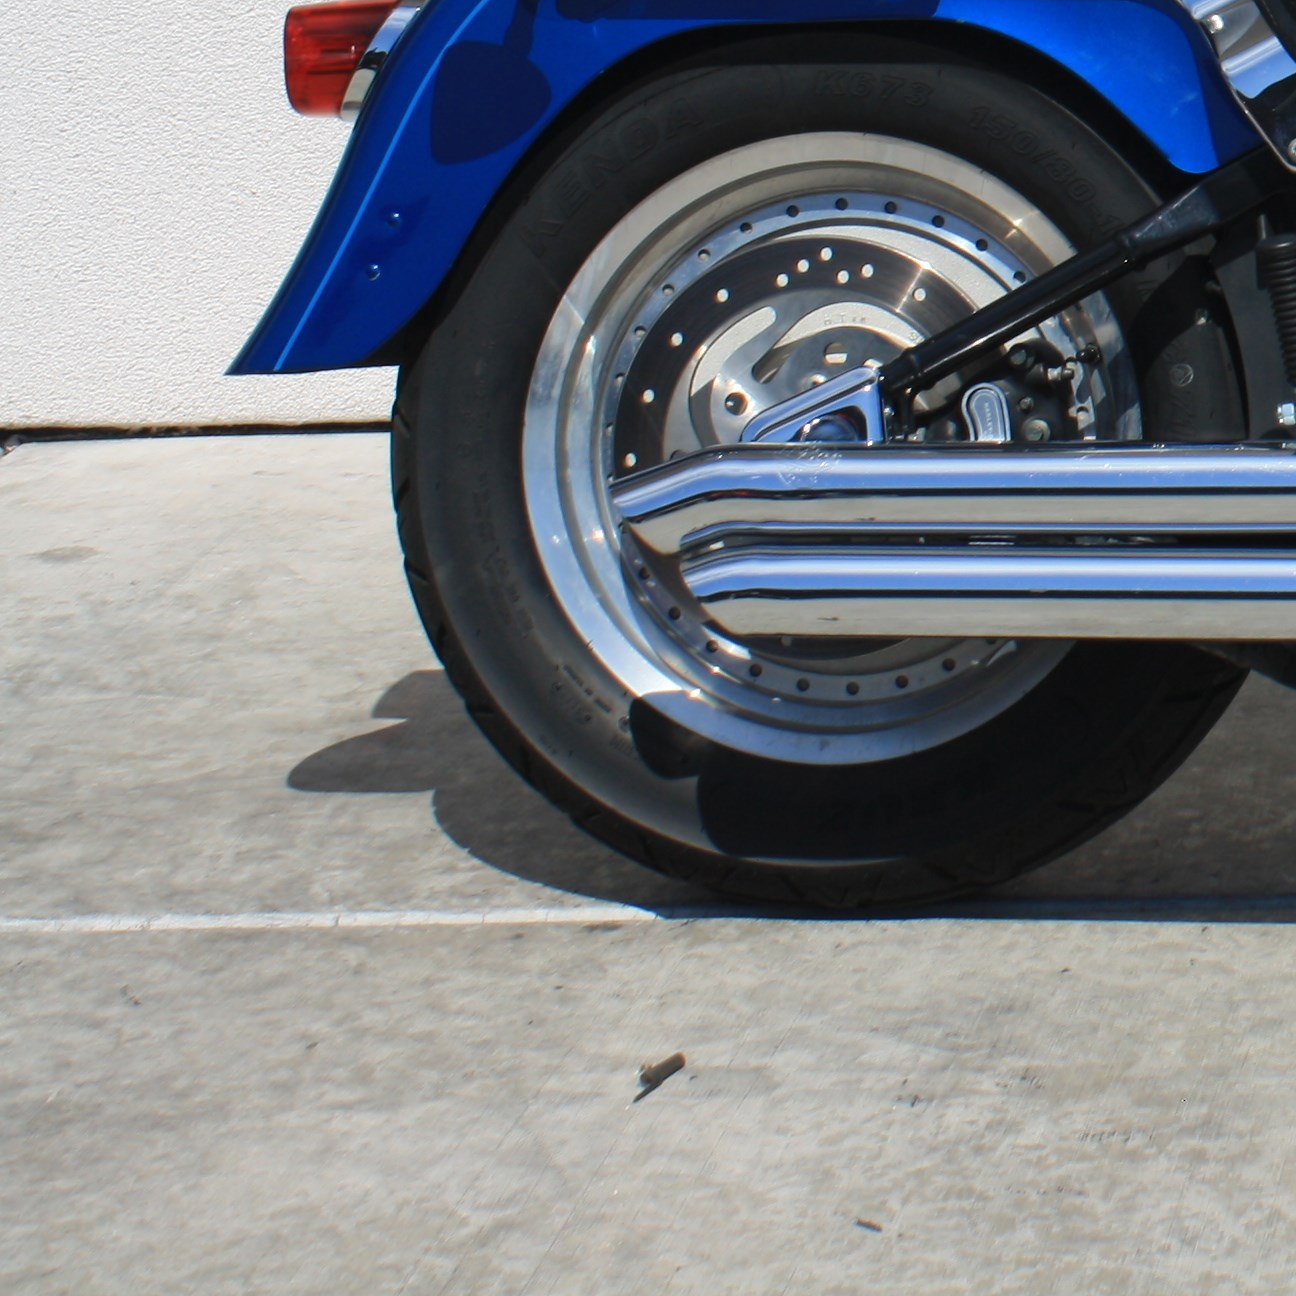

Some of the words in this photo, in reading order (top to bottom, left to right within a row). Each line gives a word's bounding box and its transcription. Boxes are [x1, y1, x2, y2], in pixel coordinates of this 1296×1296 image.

[813, 69, 934, 108] K673
[520, 95, 704, 255] KENDA
[967, 103, 1125, 235] 150/80-1
